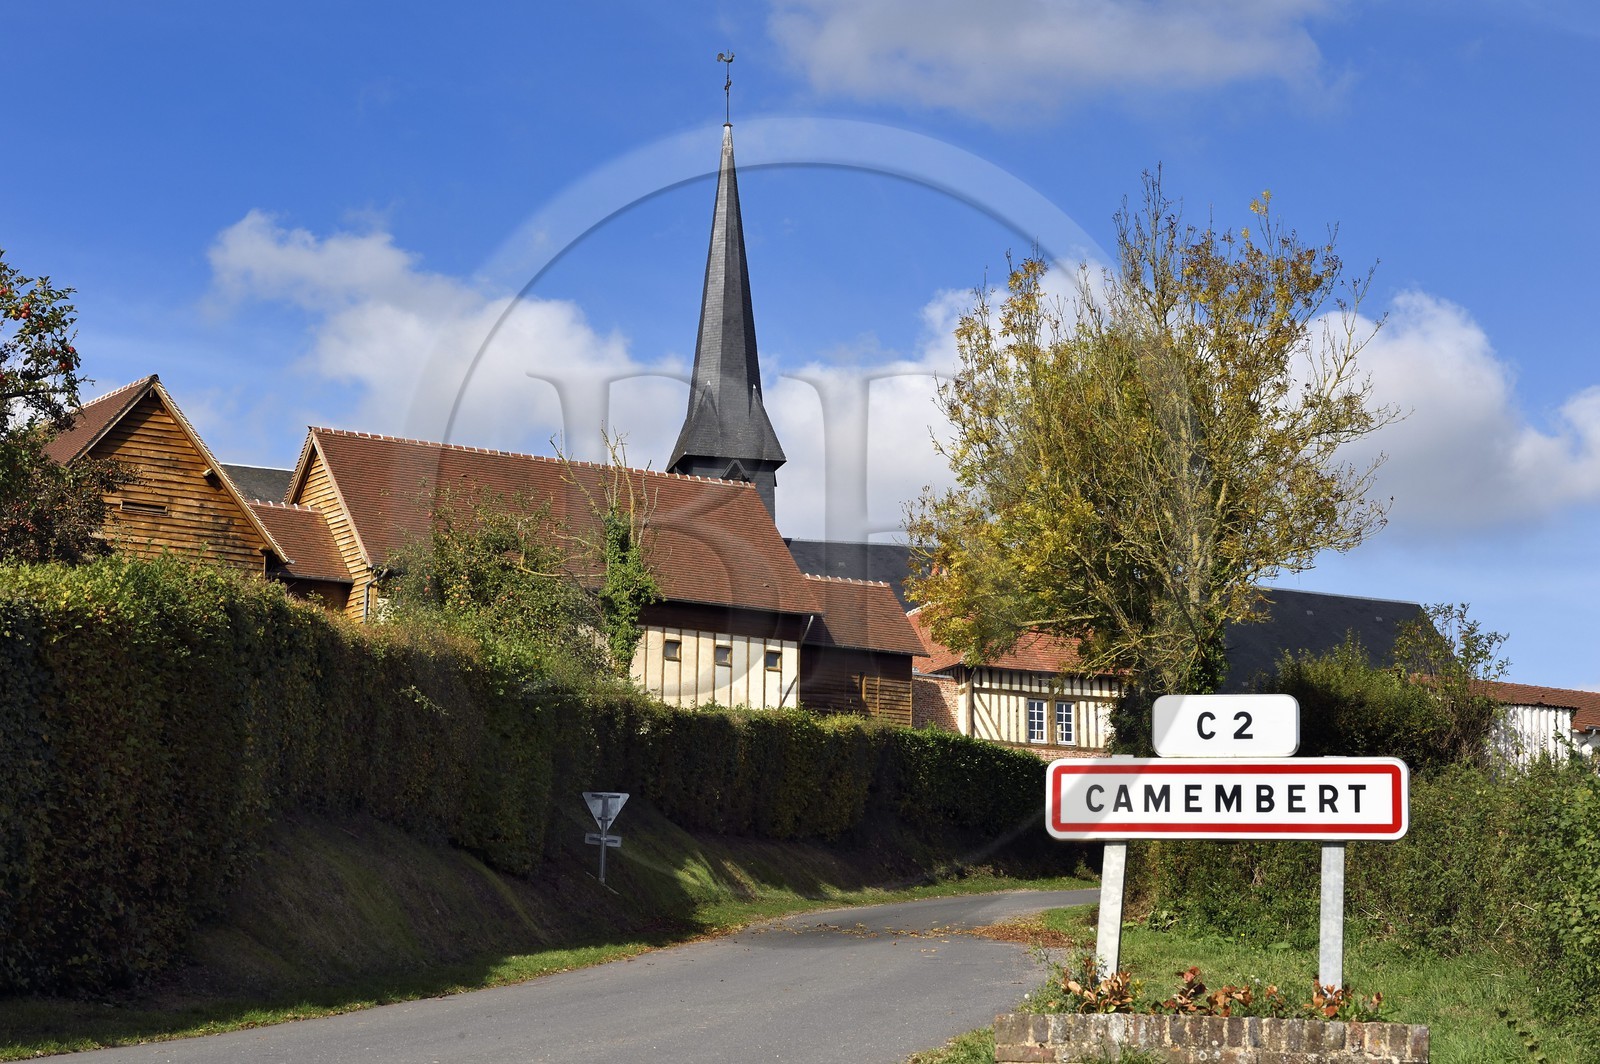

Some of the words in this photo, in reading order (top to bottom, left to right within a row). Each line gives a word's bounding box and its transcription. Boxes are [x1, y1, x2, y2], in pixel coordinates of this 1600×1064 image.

[1196, 711, 1216, 740] C
[1233, 711, 1254, 740] 2
[1085, 784, 1367, 813] CAMEMBERT
